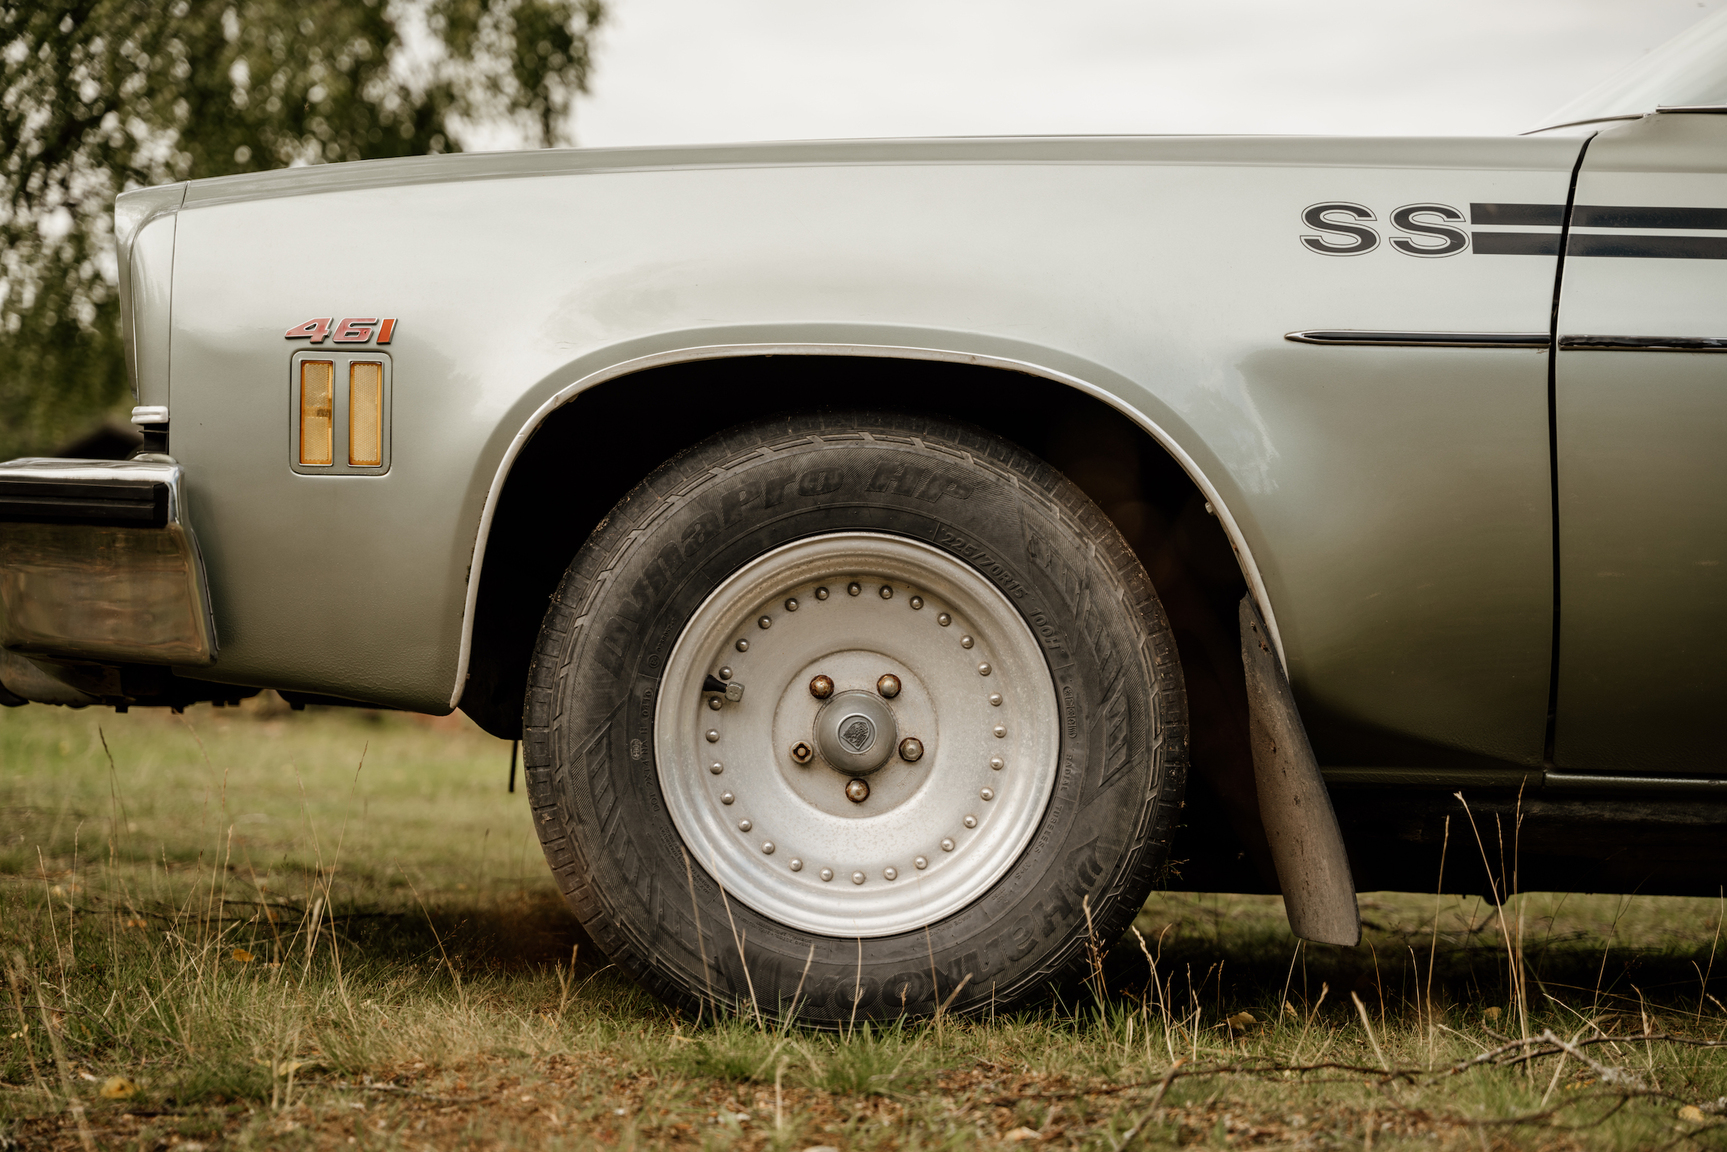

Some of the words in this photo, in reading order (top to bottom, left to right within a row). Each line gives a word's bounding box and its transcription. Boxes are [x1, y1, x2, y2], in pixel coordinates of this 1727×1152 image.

[1300, 201, 1470, 258] SS
[285, 317, 397, 344] 461
[866, 460, 975, 502] HP
[941, 531, 1029, 600] 225/70R15
[1029, 606, 1061, 651] 100H
